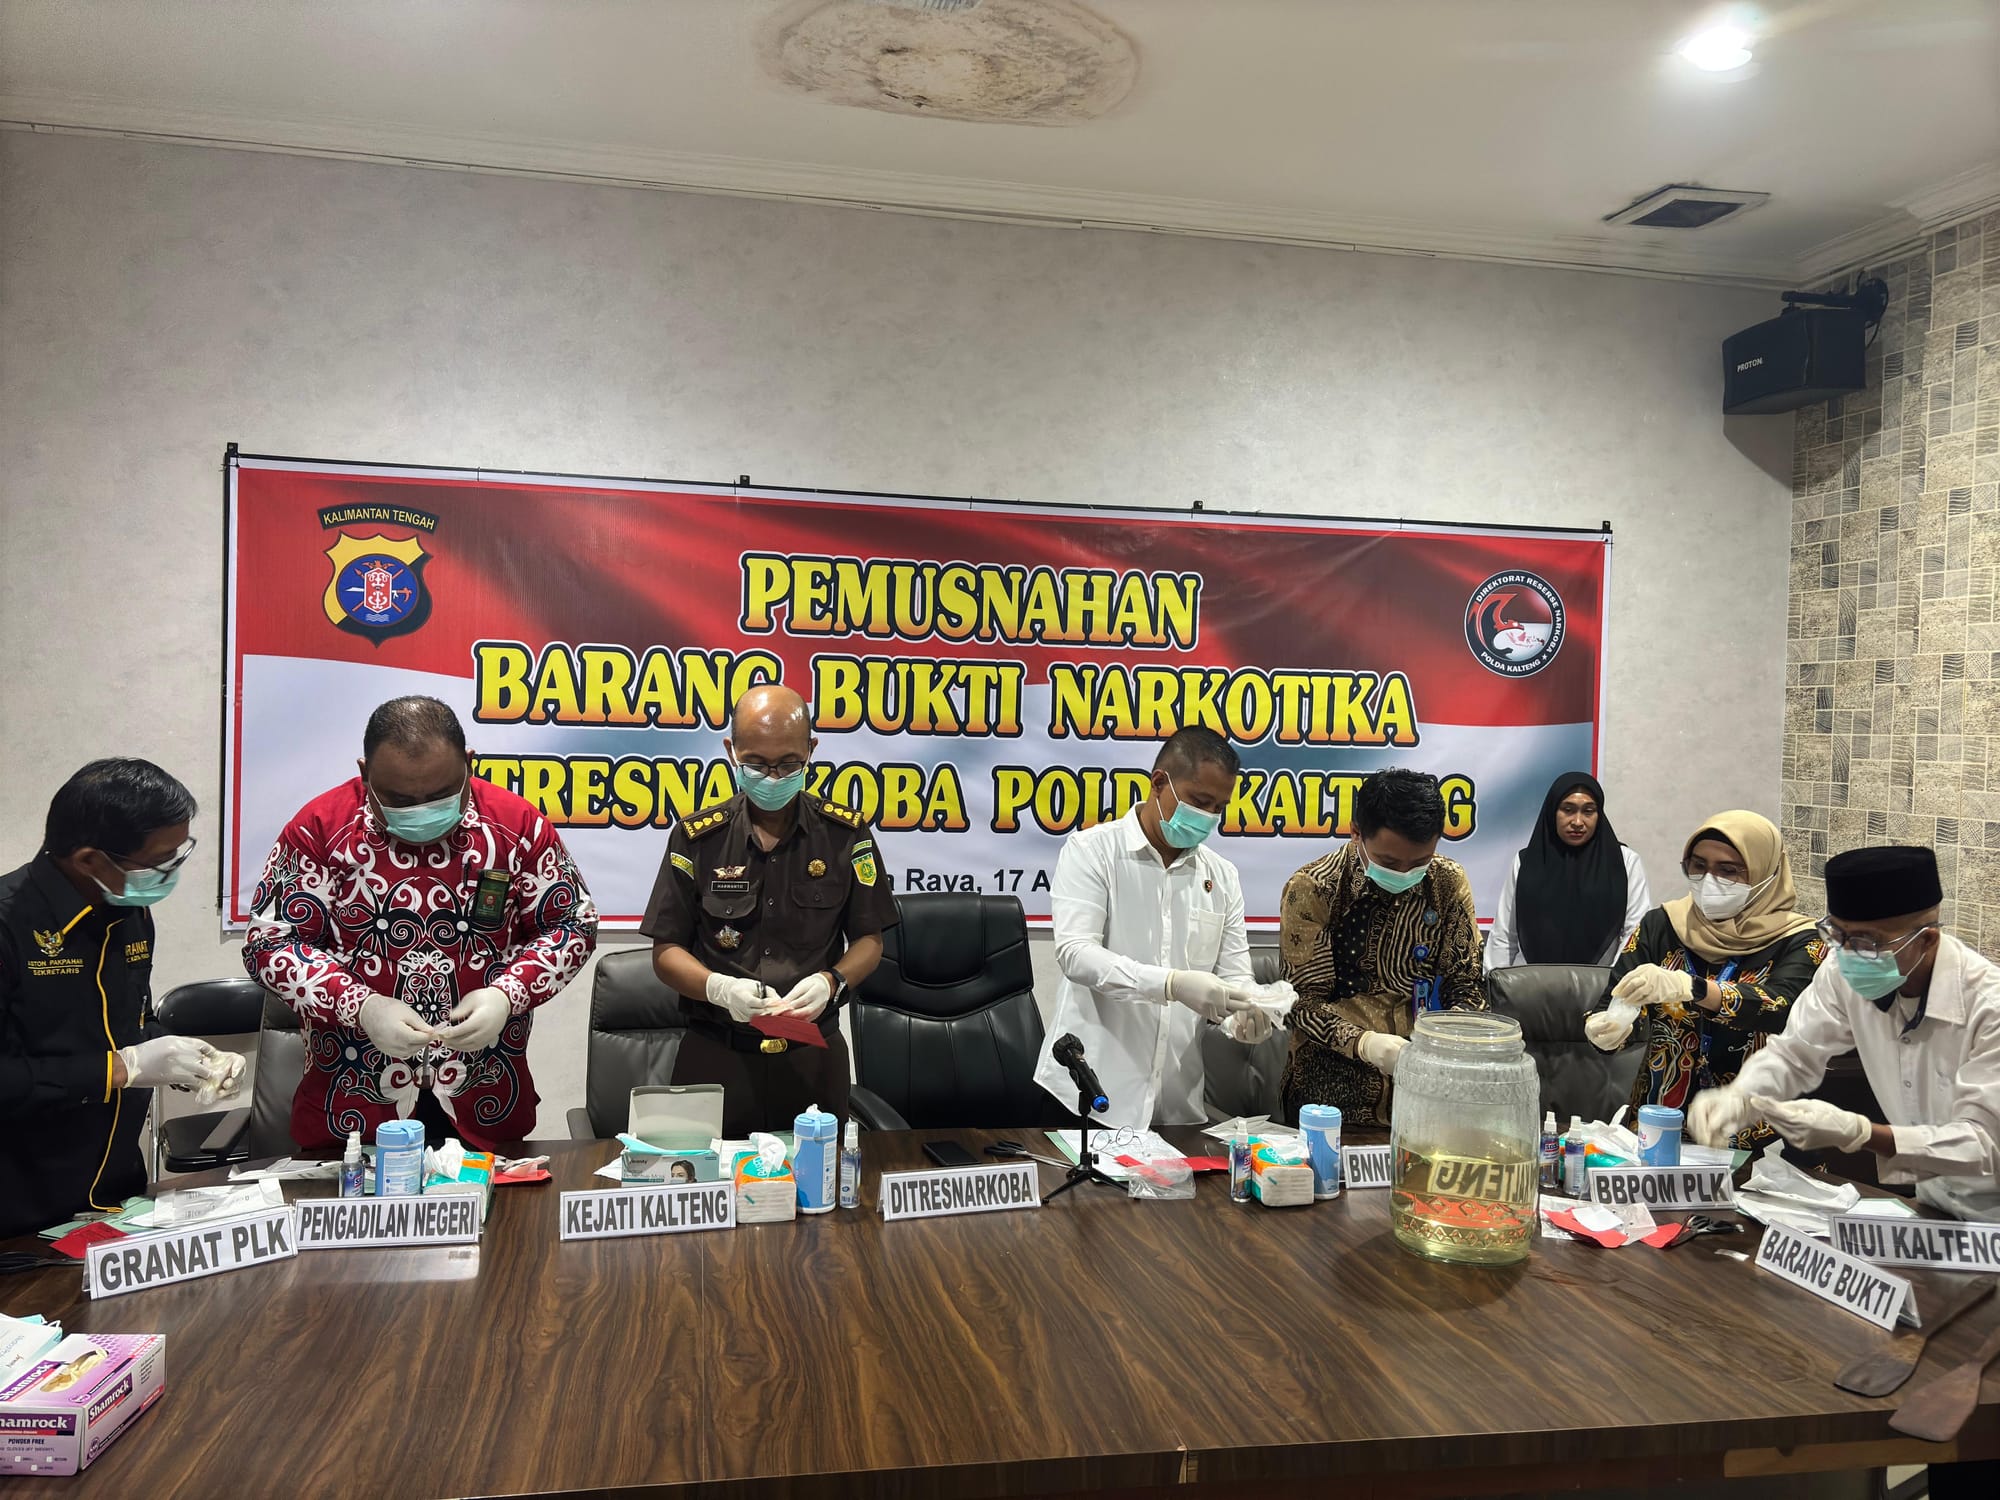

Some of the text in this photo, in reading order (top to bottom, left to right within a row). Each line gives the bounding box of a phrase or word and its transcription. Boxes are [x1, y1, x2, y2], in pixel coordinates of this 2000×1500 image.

[1737, 357, 1763, 373] PROTON
[323, 508, 435, 530] KALIMANTAN TENGAH
[742, 554, 1200, 648] PEMUSNAHAN
[1476, 575, 1562, 653] DIREKTORAT RESERSE NARKOBA
[1481, 651, 1541, 673] POLDA KALTENG
[813, 656, 1024, 737] BUKTI
[1050, 664, 1420, 748] NARKOTIKA
[992, 766, 1151, 833] POLD
[1219, 770, 1477, 840] KALTG
[994, 869, 1024, 892] 17
[32, 967, 80, 976] SEKRETARIS
[890, 1172, 1033, 1215] DITRESNARKOBA
[1596, 1172, 1729, 1204] BBPOM PLK
[300, 1203, 408, 1242] PENGADILAN
[414, 1201, 475, 1237] NEGERI
[566, 1190, 729, 1235] KEJATI KALTENG
[100, 1217, 289, 1292] GRANAT PLK
[1838, 1222, 2000, 1265] MUI KALTENG
[1762, 1229, 1897, 1320] BARANG BUKTI
[0, 1362, 54, 1400] Shamrock
[89, 1379, 130, 1420] Shamrock
[0, 1416, 68, 1429] amrock
